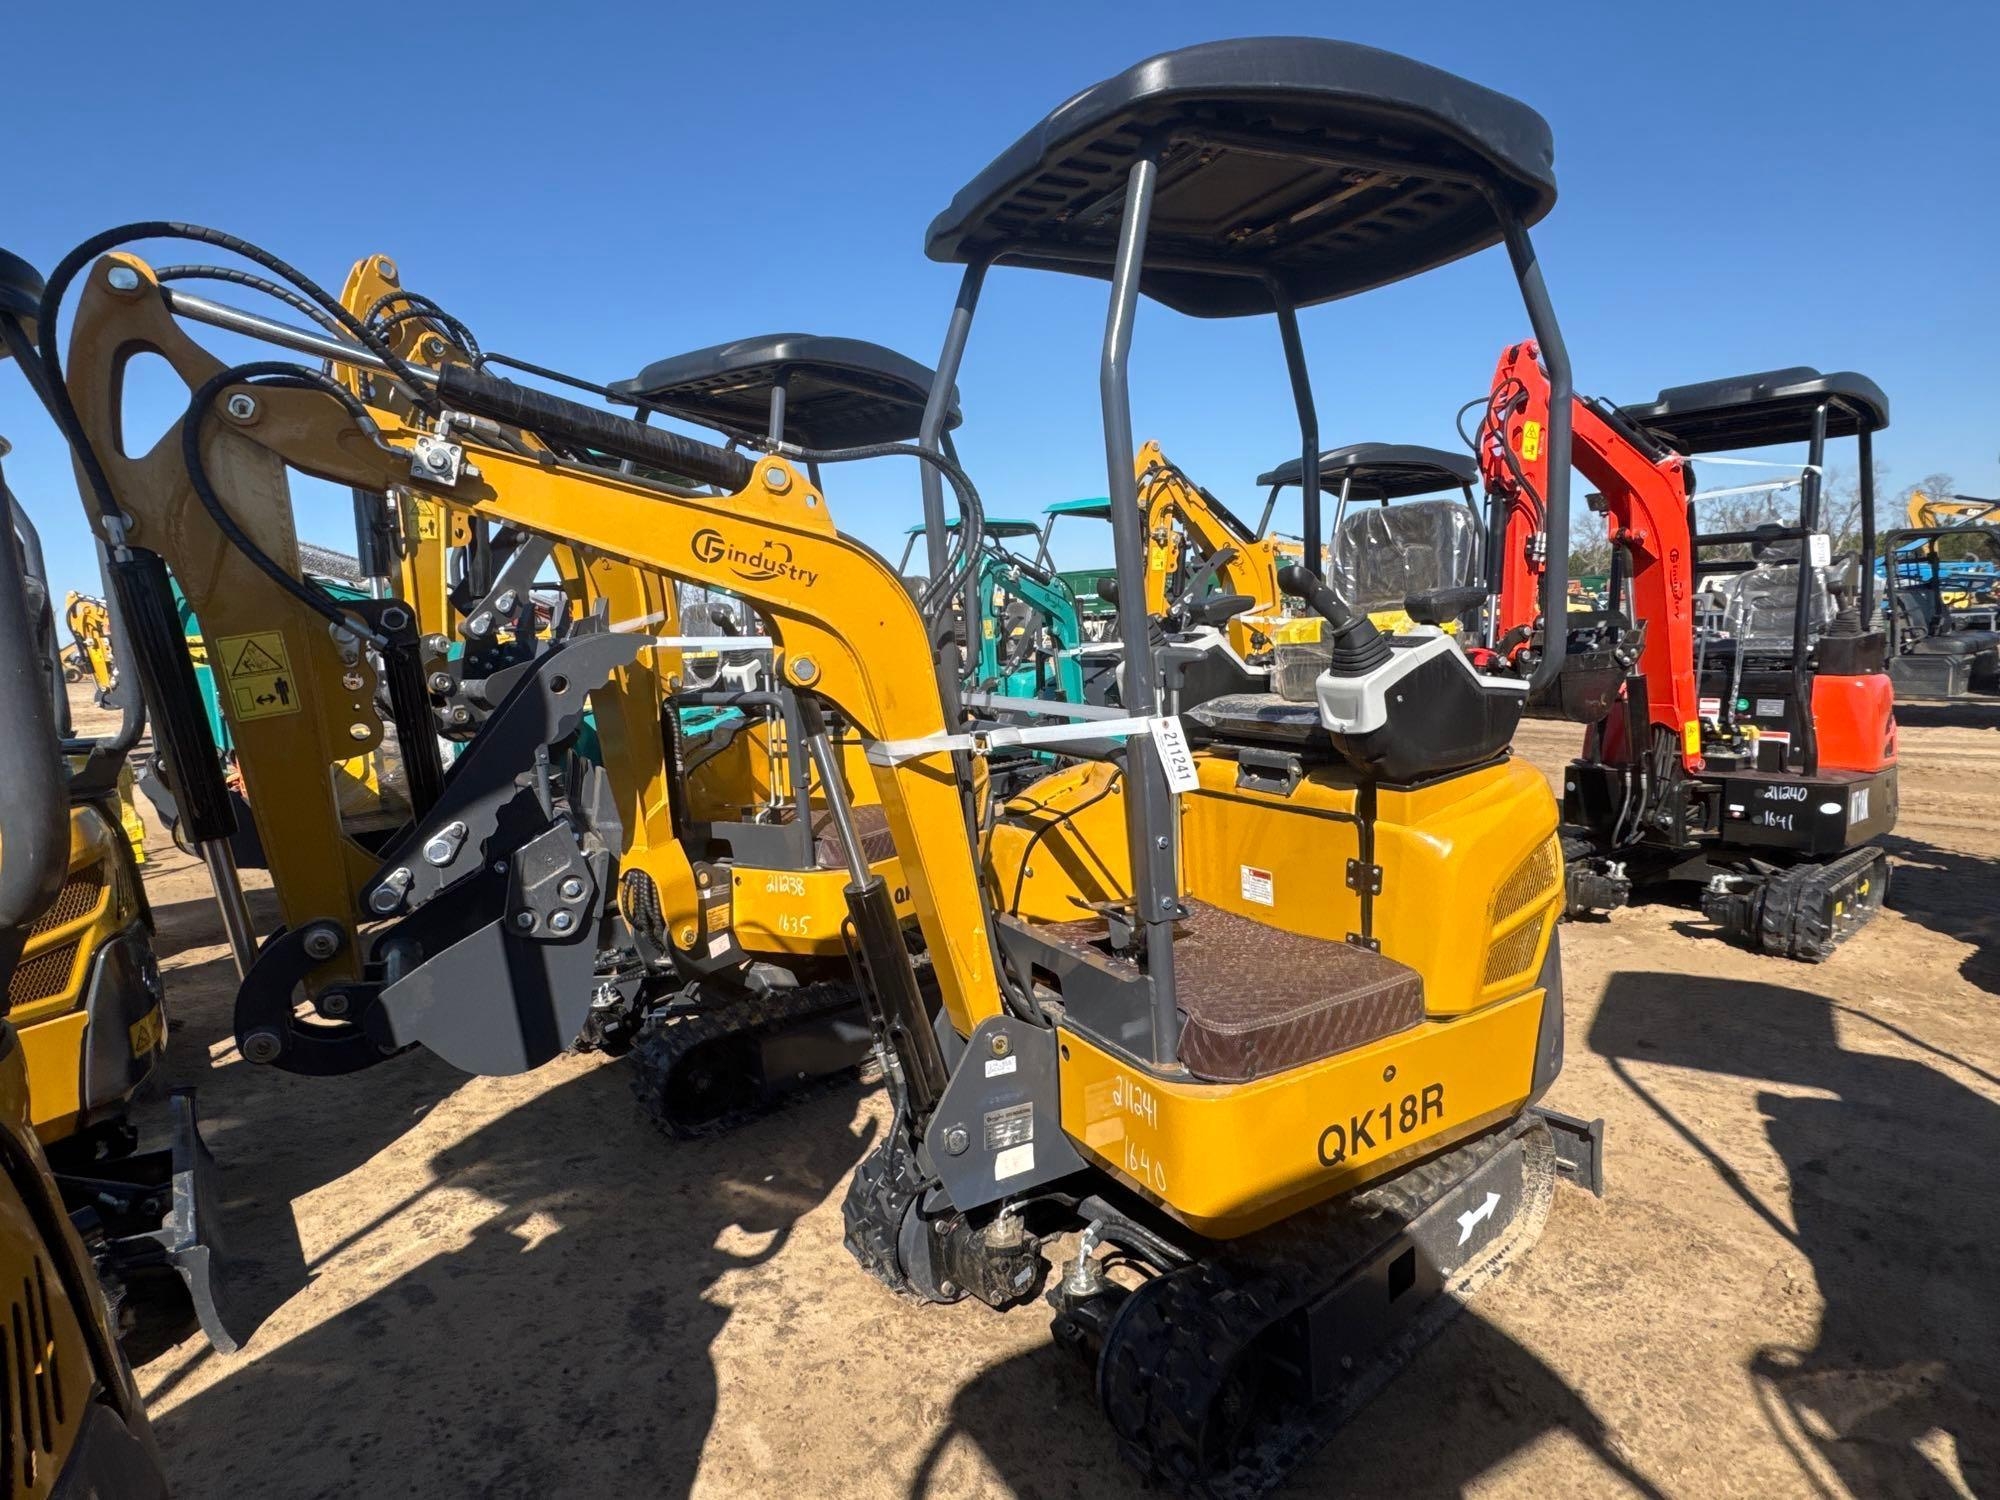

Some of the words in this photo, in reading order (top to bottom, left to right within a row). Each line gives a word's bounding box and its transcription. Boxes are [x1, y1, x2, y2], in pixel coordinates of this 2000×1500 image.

[1163, 732, 1191, 780] 211241
[1764, 785, 1808, 801] 211240
[1764, 810, 1794, 831] 1641
[766, 875, 805, 897] 211238
[778, 914, 812, 935] 1635
[1112, 1074, 1158, 1130] 211241
[1317, 1082, 1444, 1168] QK18R
[1124, 1135, 1166, 1192] 1640
